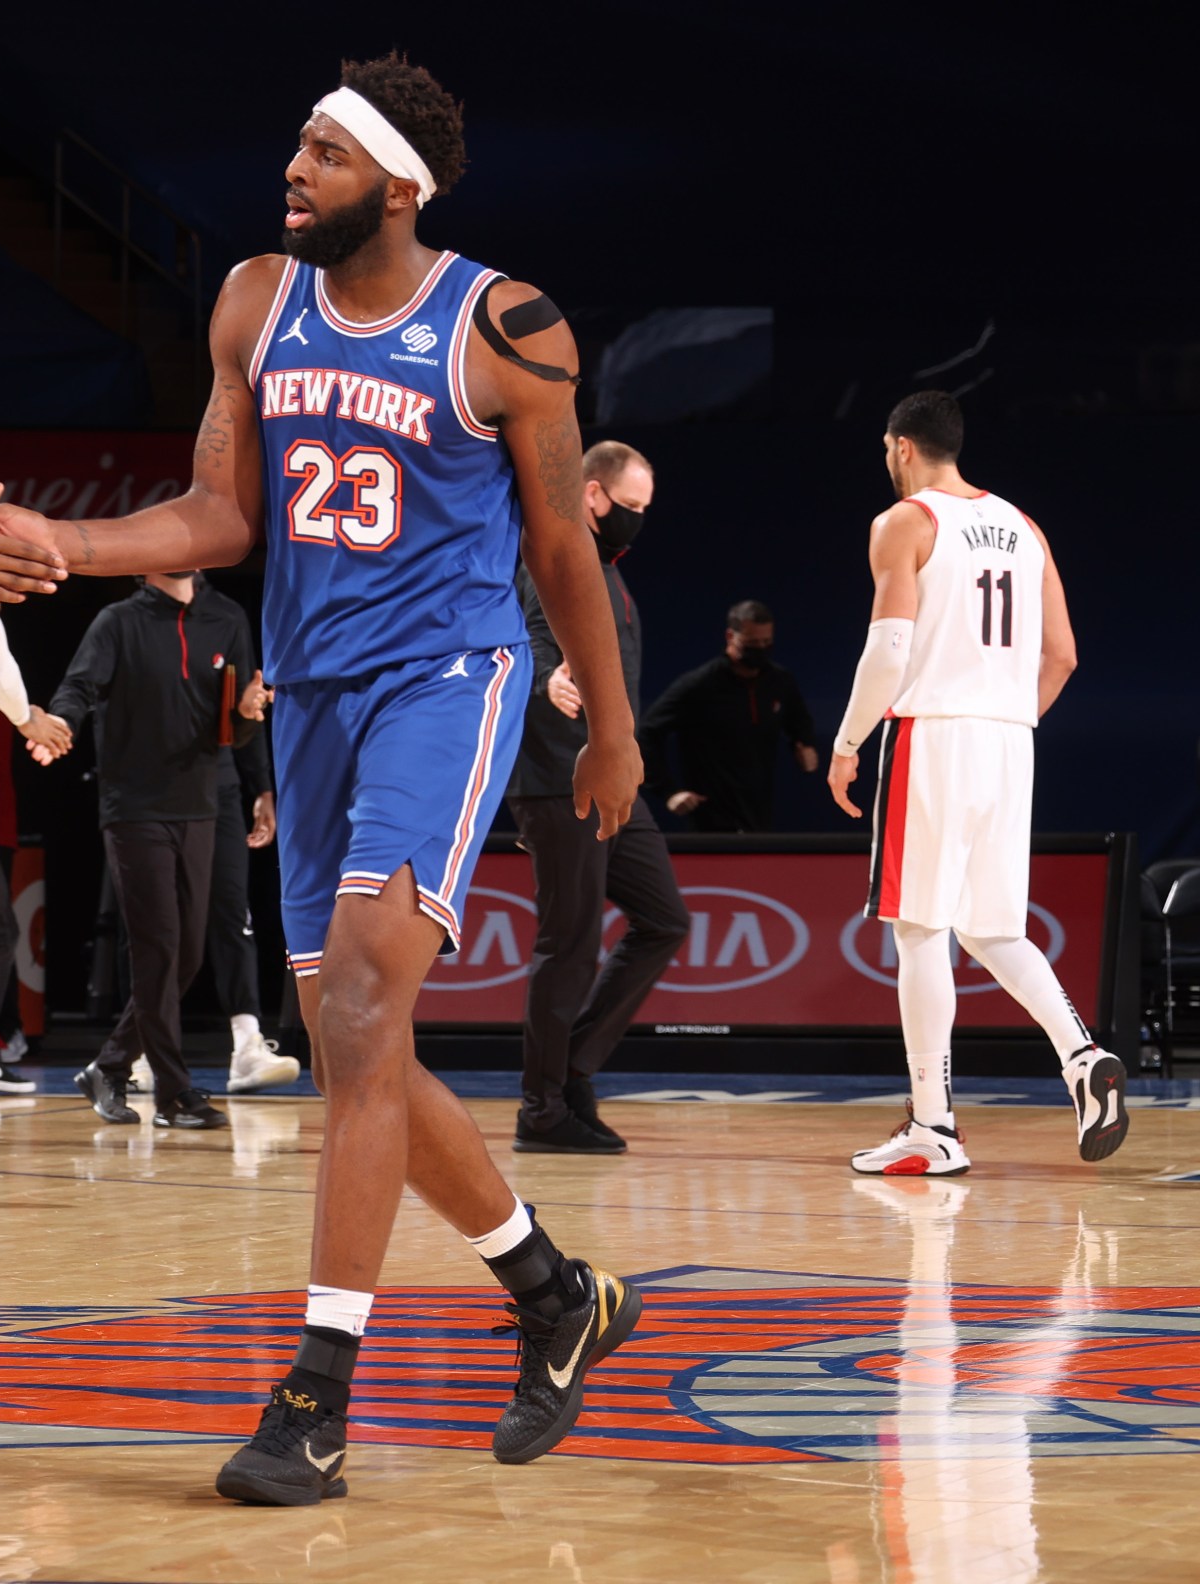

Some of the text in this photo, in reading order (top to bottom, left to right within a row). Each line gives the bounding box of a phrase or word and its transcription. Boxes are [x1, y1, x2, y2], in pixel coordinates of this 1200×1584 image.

[389, 352, 439, 367] SQUARESPACE
[262, 368, 436, 446] NEW YORK
[284, 438, 402, 552] 23
[961, 525, 1018, 554] KANTER
[976, 569, 1013, 648] 11
[669, 911, 770, 967] IA
